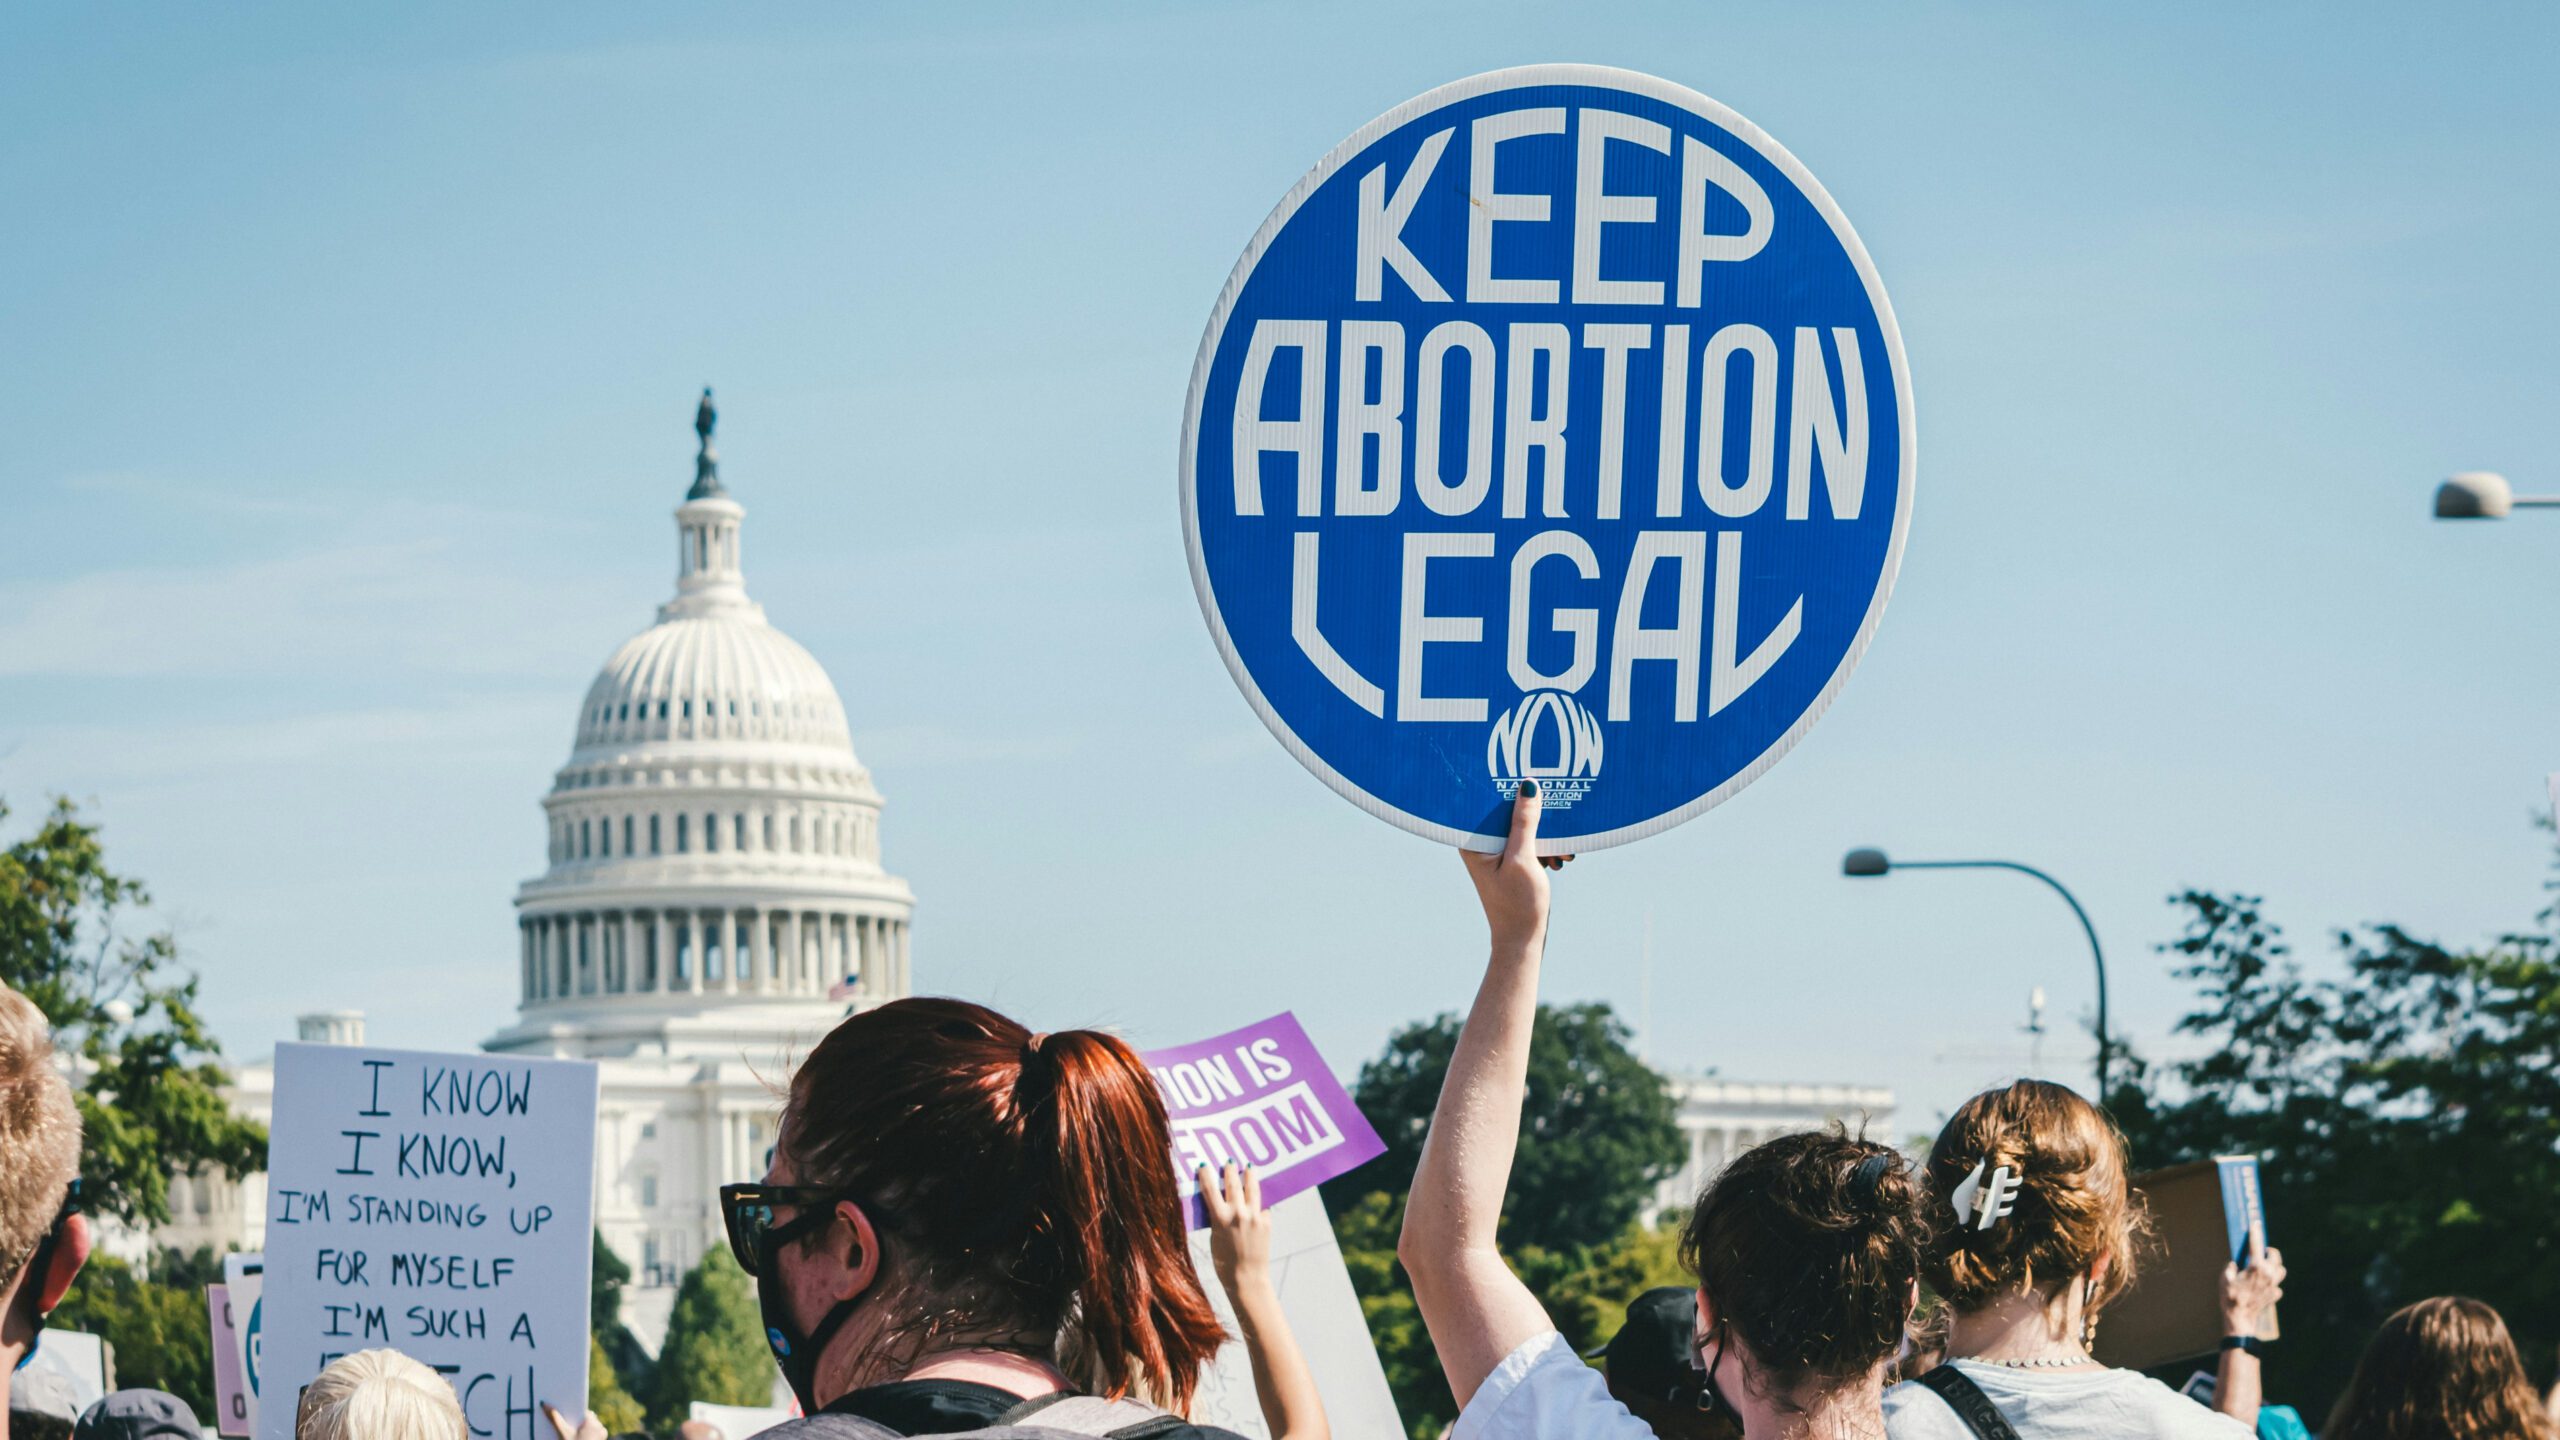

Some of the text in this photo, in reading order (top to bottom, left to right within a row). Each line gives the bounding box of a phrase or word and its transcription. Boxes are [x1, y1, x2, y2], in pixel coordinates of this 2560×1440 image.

[1355, 106, 1776, 308] KEEP
[1232, 319, 1869, 521] ABORTION
[1291, 529, 1804, 723] LEGAL
[1487, 692, 1604, 777] NOW
[1496, 781, 1592, 789] NAONAL
[358, 1060, 532, 1117] I KNOW
[1150, 1037, 1293, 1110] ION IS
[336, 1130, 517, 1189] I KNOW,
[1174, 1093, 1330, 1181] EDOM
[276, 1189, 553, 1236] I'M STANDING UP
[316, 1249, 516, 1289] FOR MYSELF
[322, 1302, 536, 1349] I'M SUCH A
